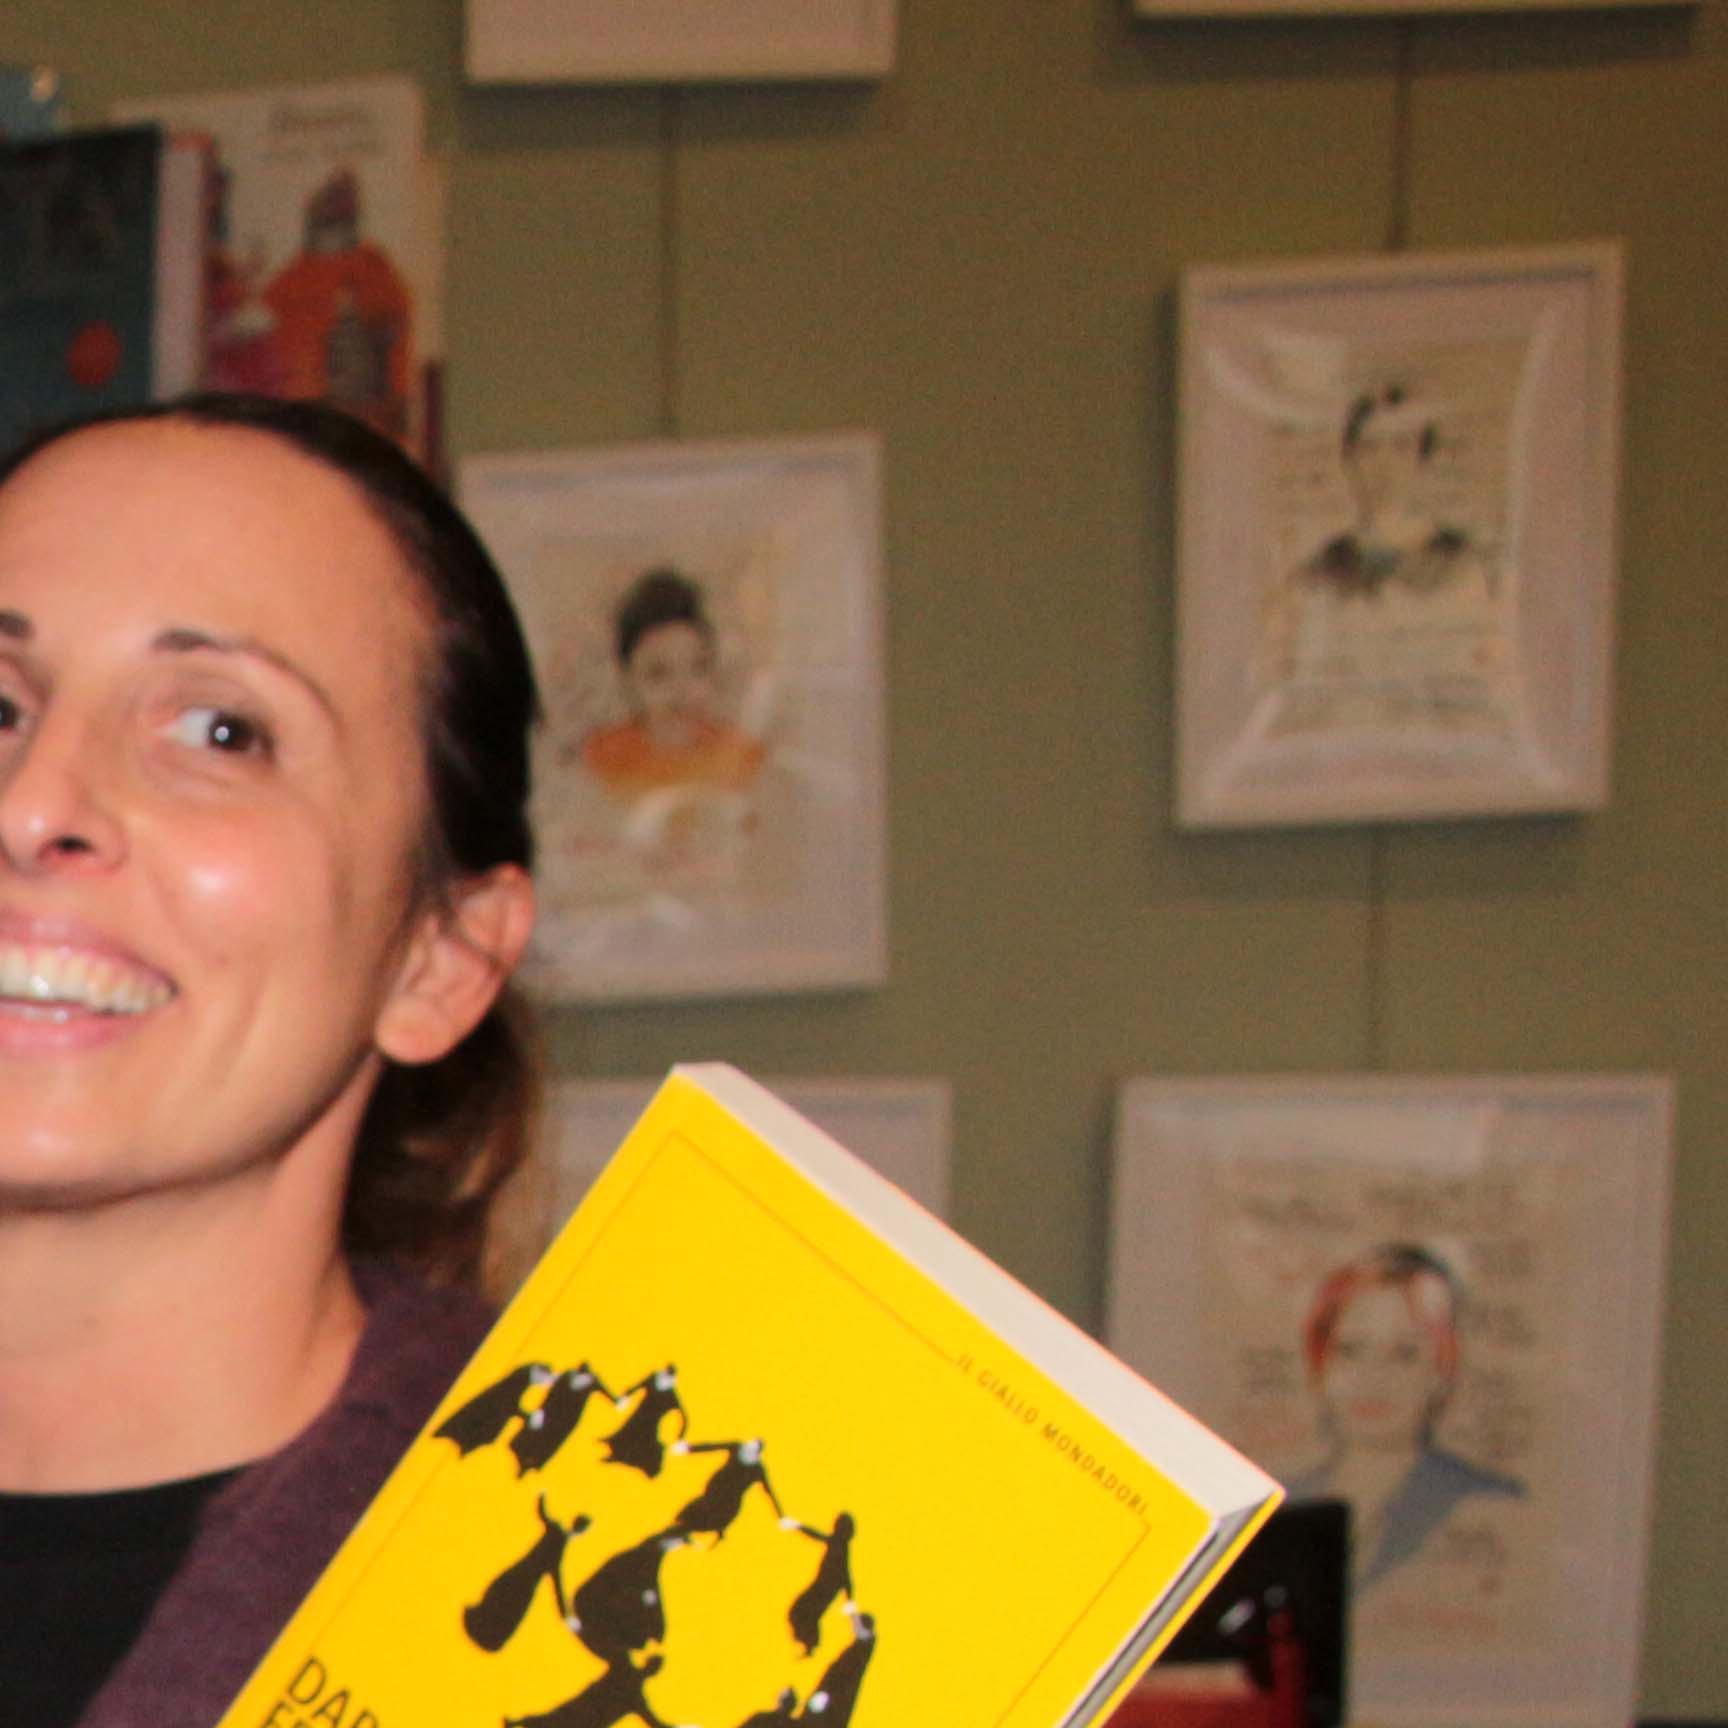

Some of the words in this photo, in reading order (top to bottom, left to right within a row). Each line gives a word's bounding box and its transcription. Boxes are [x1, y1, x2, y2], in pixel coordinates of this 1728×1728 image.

[955, 1351, 974, 1375] IL
[976, 1367, 1041, 1426] GIALLO
[1039, 1421, 1150, 1518] MONDADORI
